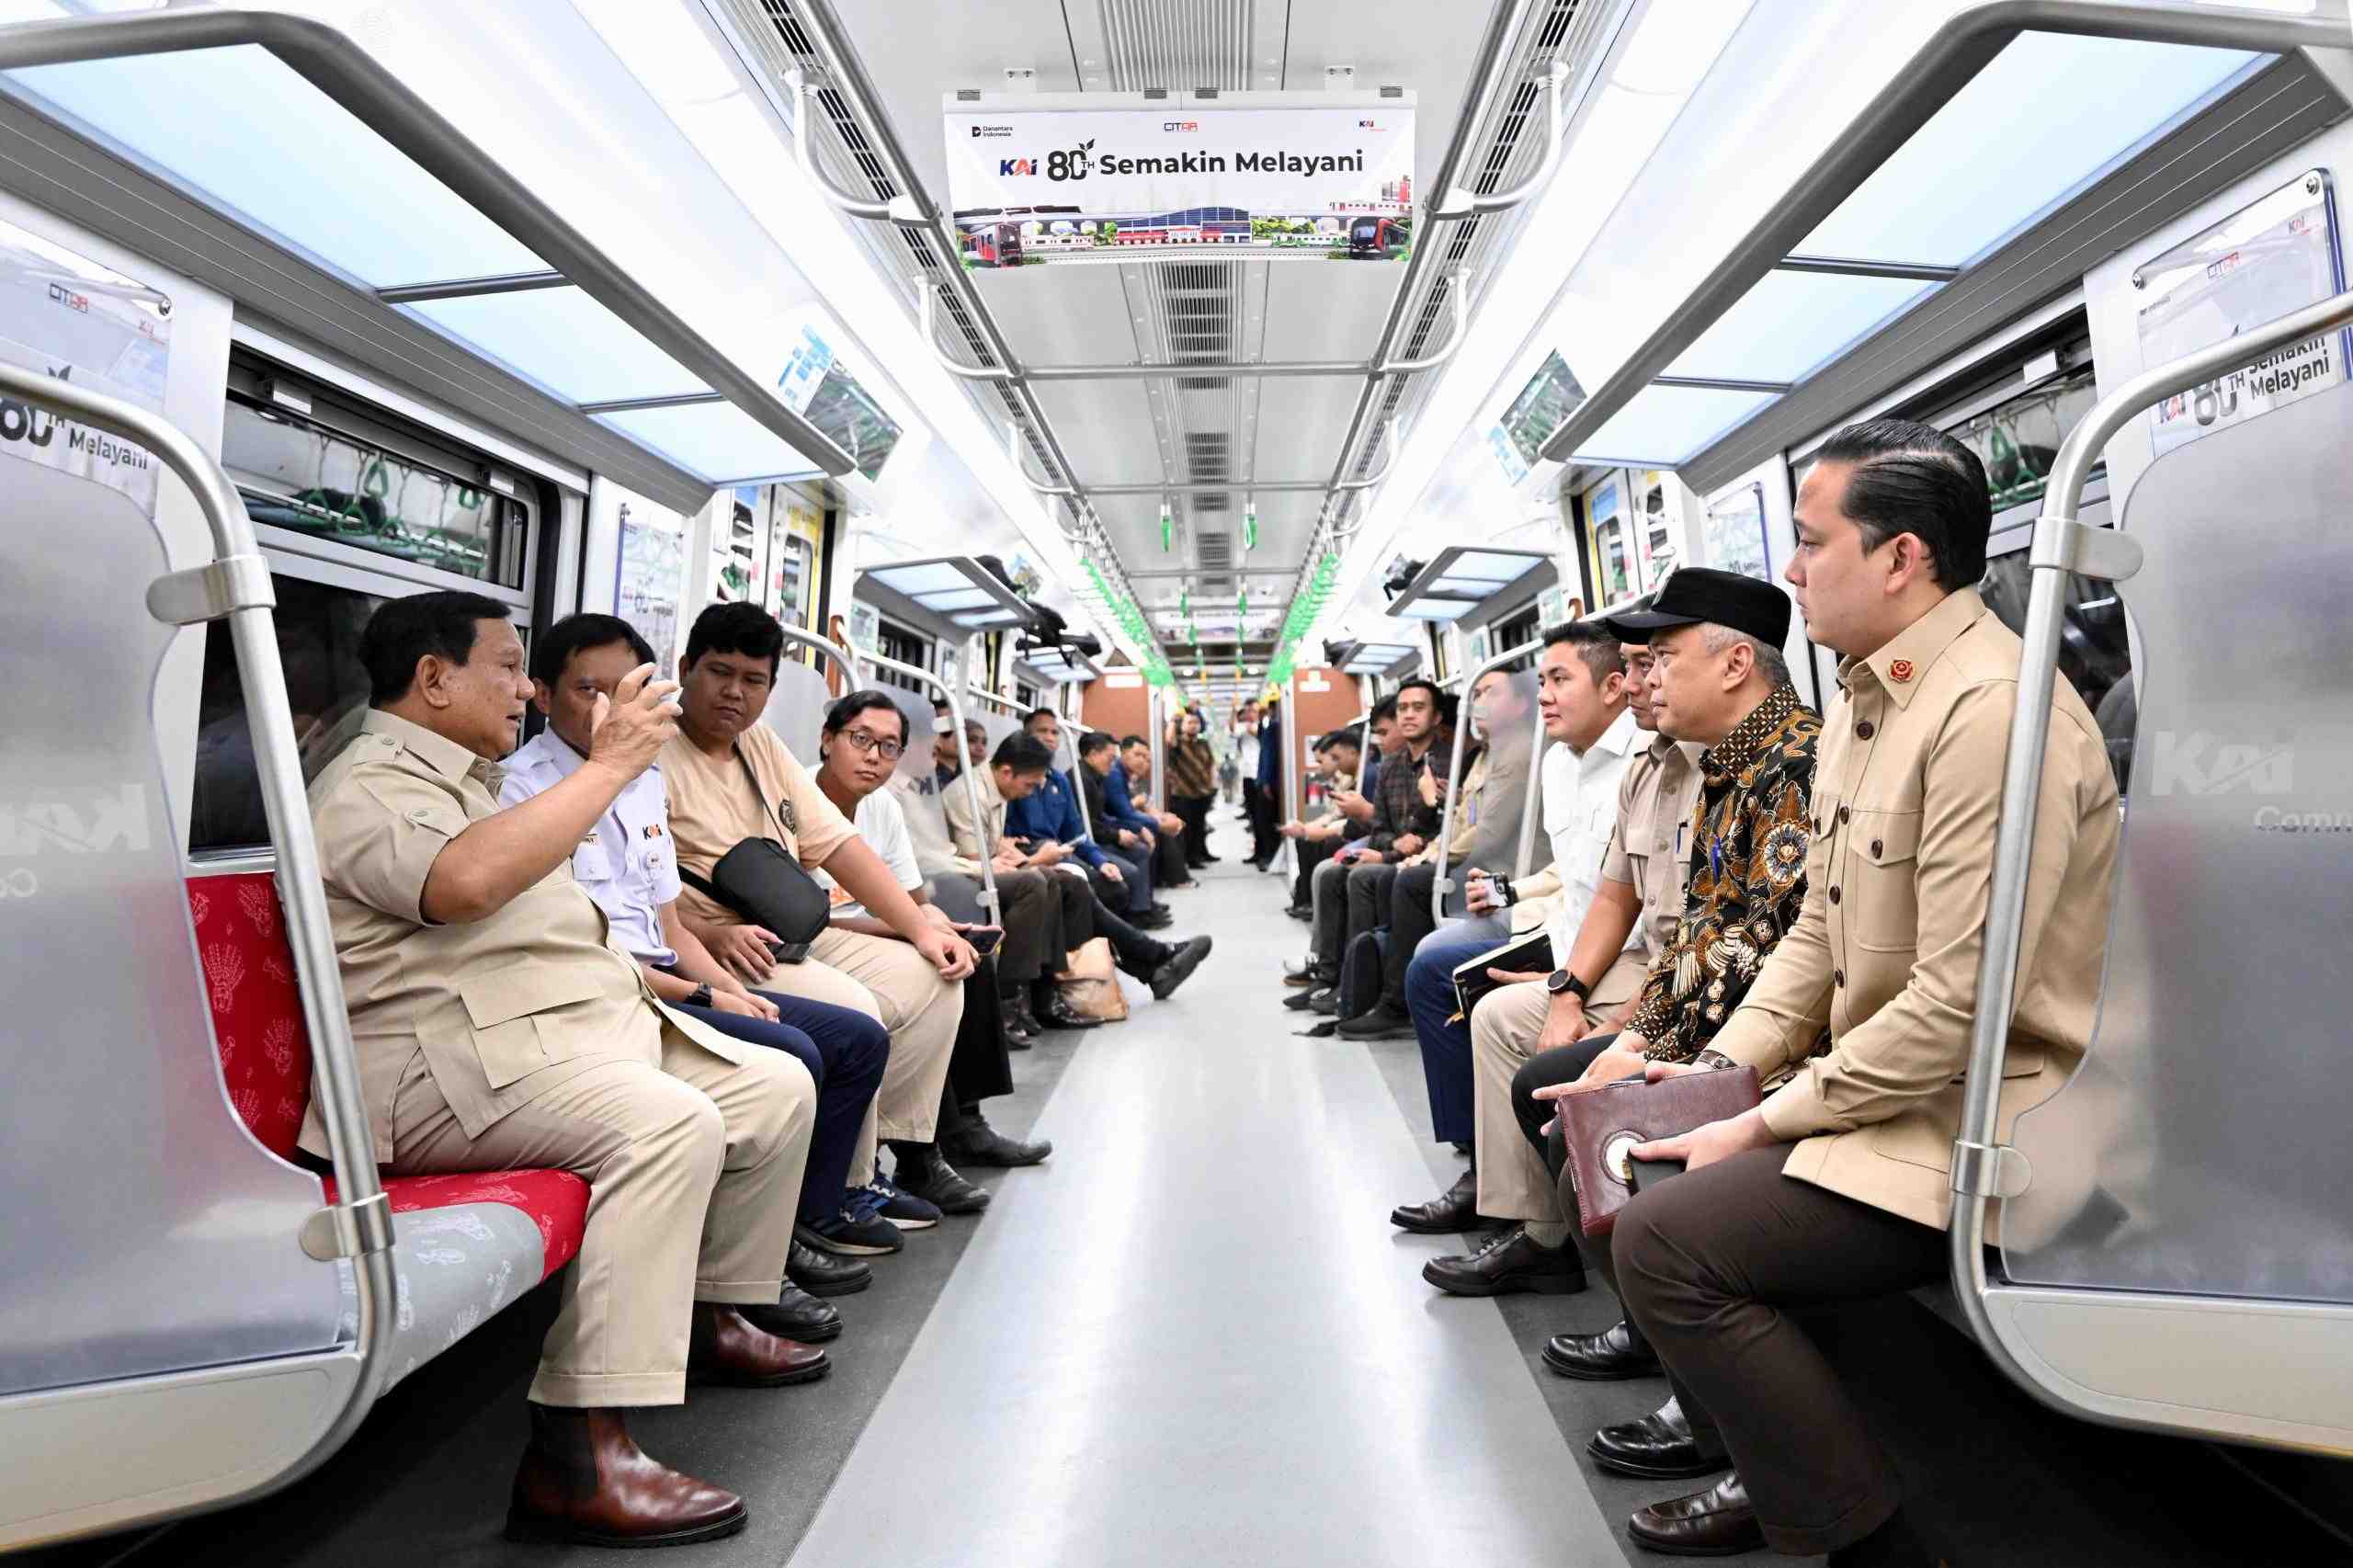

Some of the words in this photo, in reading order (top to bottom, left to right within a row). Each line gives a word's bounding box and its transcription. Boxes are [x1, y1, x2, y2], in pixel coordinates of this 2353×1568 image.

[1099, 150, 1227, 175] Semakin
[1236, 149, 1363, 176] Melayani
[2250, 349, 2330, 401] Melayani
